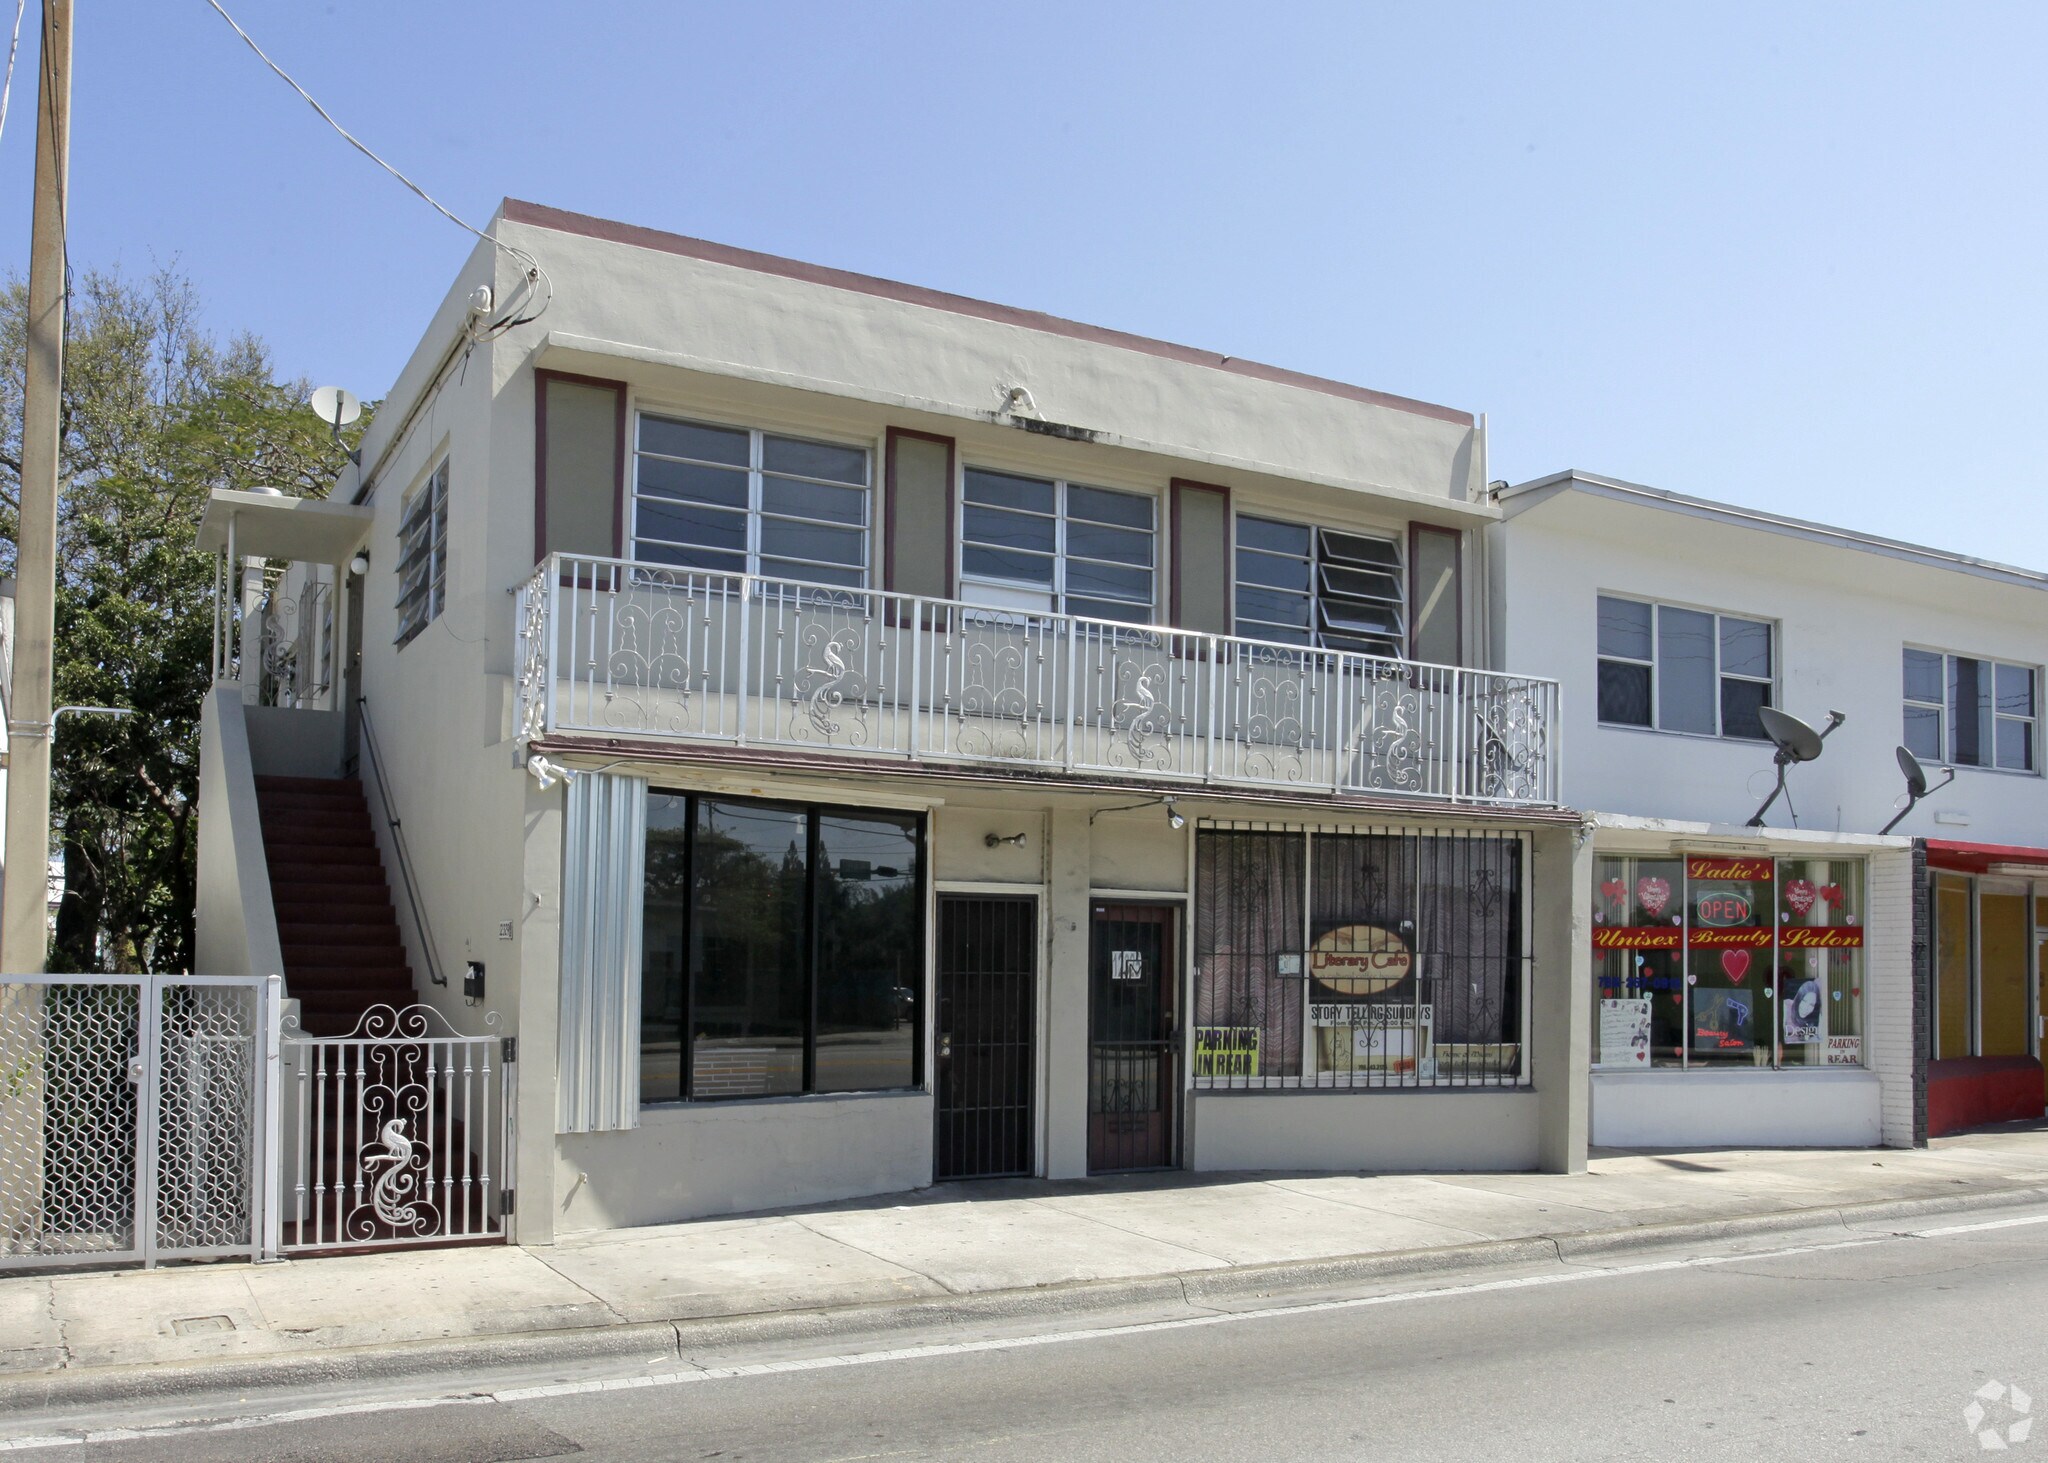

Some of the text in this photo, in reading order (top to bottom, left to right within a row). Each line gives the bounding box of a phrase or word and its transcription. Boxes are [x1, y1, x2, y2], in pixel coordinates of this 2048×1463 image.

[1688, 861, 1771, 880] Ladie's
[1701, 900, 1747, 919] OPEN
[1592, 928, 1860, 946] Unisex Beauty Salon
[1312, 949, 1369, 972] Literary
[1785, 1023, 1818, 1037] Design
[1827, 1038, 1860, 1048] PARKING
[1197, 1054, 1213, 1075] IN
[1827, 1054, 1857, 1064] REAR
